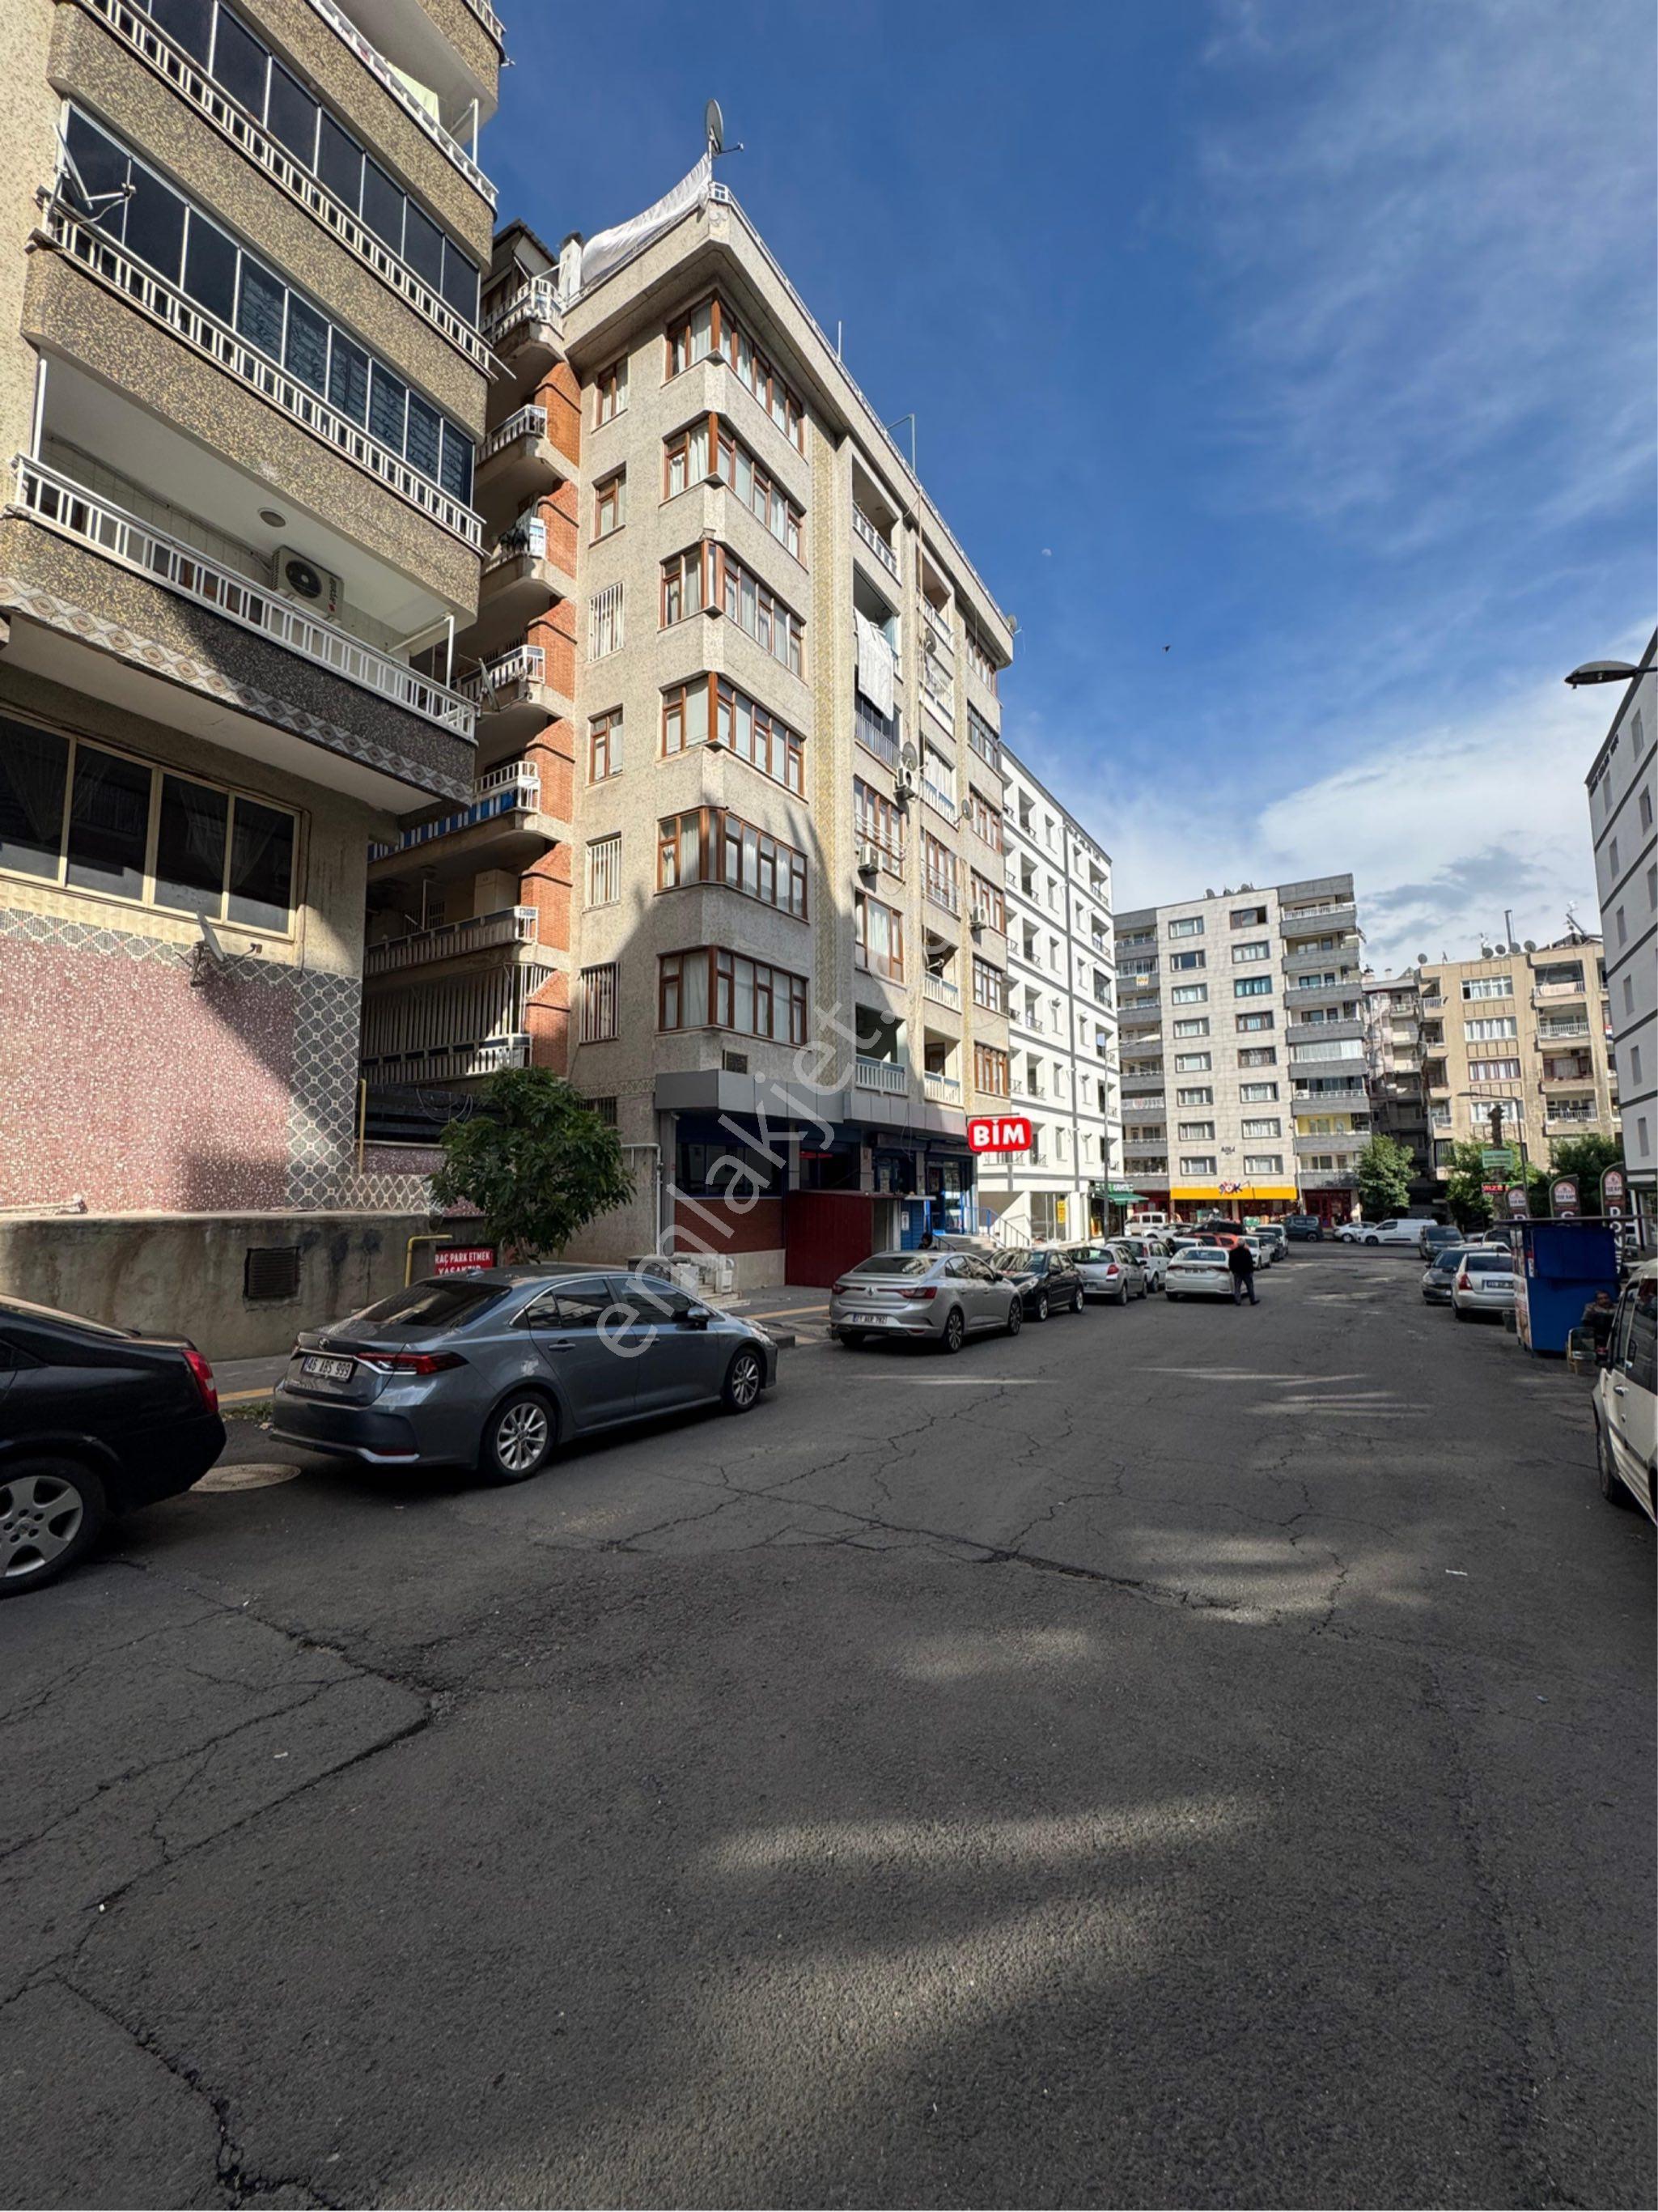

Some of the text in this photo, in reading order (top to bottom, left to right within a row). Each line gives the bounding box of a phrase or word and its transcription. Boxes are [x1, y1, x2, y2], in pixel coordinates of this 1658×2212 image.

[973, 1120, 1025, 1147] BİM
[450, 1251, 468, 1263] PARK
[469, 1250, 490, 1262] ETMEK
